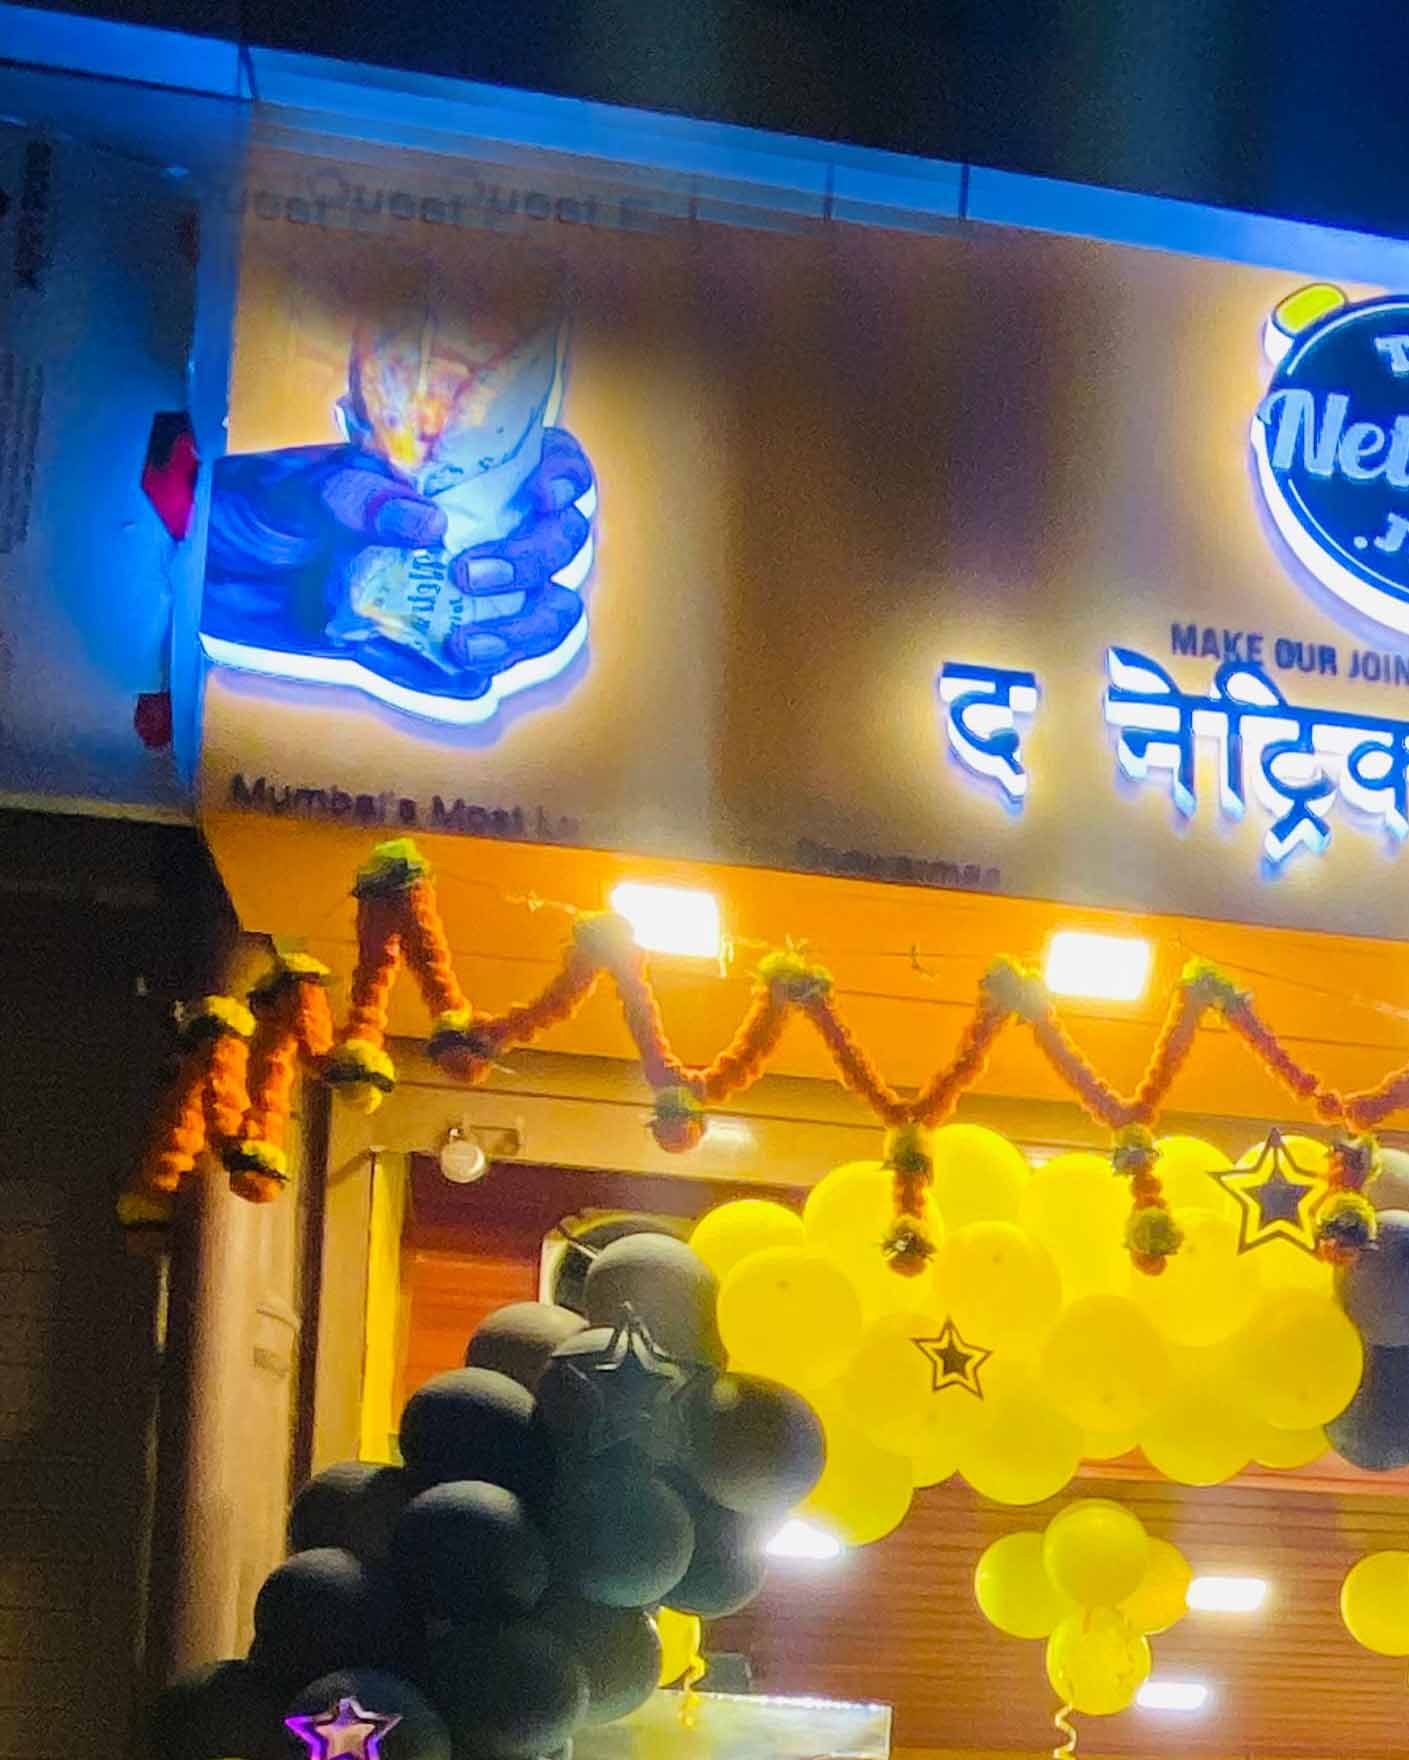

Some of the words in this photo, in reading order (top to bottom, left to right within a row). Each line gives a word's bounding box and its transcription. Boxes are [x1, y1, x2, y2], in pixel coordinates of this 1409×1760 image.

[1170, 622, 1264, 664] MAKE
[1274, 636, 1337, 676] OUR
[937, 661, 1038, 797] द
